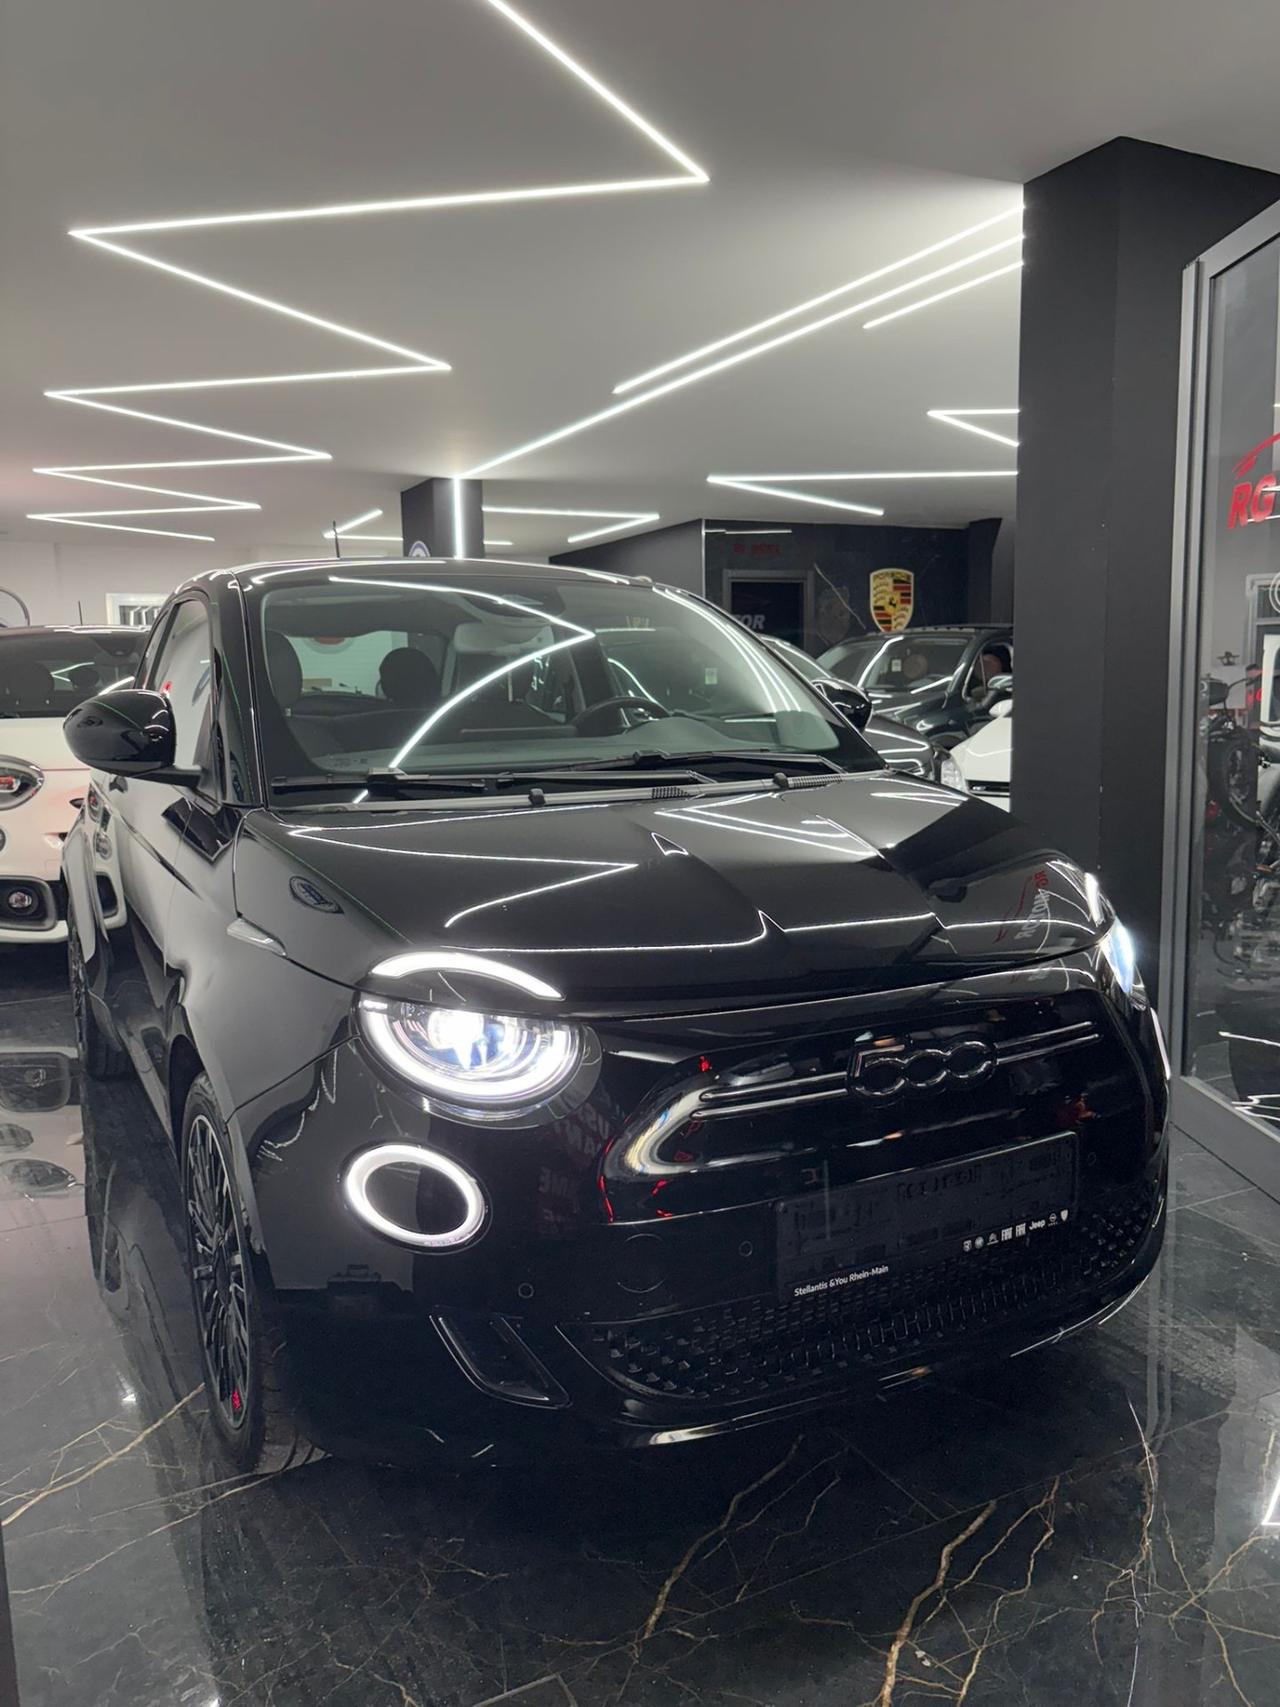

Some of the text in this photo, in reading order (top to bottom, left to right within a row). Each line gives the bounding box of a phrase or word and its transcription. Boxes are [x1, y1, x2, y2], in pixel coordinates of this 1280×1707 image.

[1228, 474, 1276, 529] RG
[850, 1039, 994, 1098] 500
[794, 1265, 889, 1297] Stellantis &You Rhein-Main
